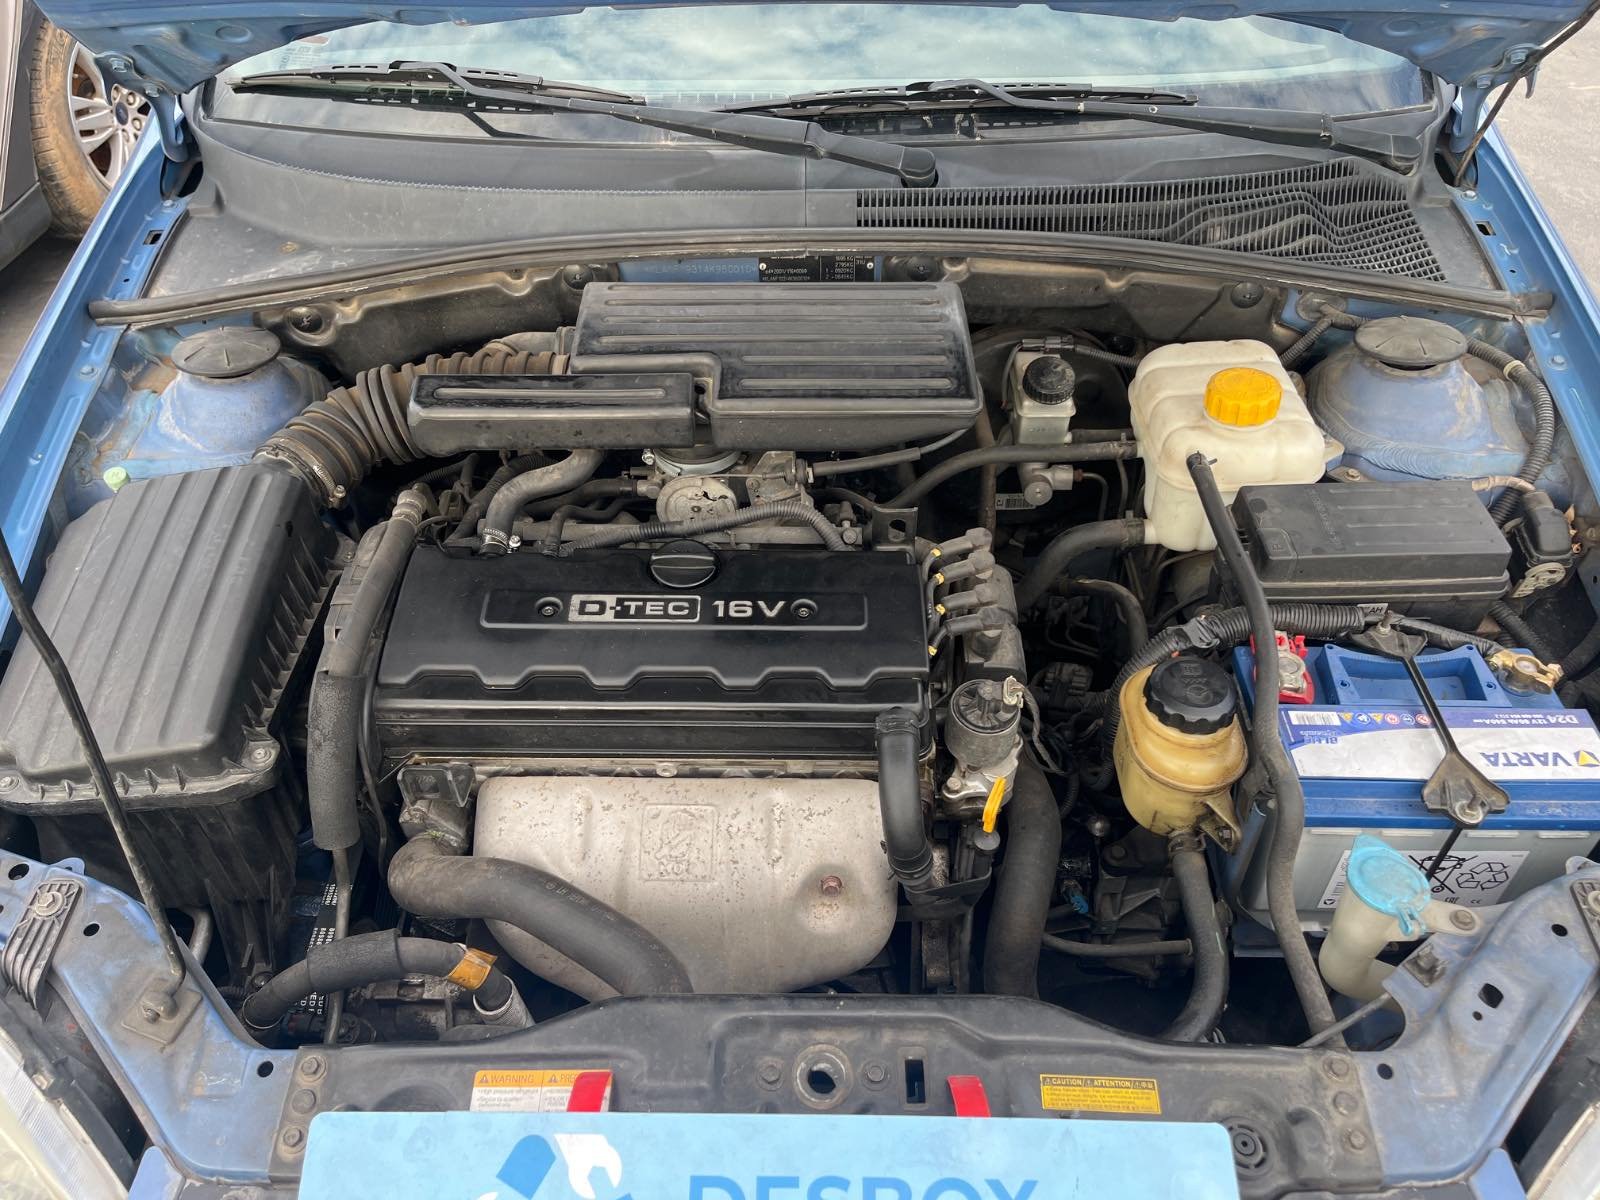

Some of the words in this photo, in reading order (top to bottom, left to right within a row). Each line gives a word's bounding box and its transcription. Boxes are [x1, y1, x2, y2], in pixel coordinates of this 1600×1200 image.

[712, 600, 785, 617] 16V
[1546, 714, 1579, 724] D24
[1480, 752, 1572, 767] VARTA
[491, 1073, 535, 1084] WARNING
[1052, 1078, 1082, 1086] CAUTION
[1093, 1079, 1131, 1088] ATTENTION
